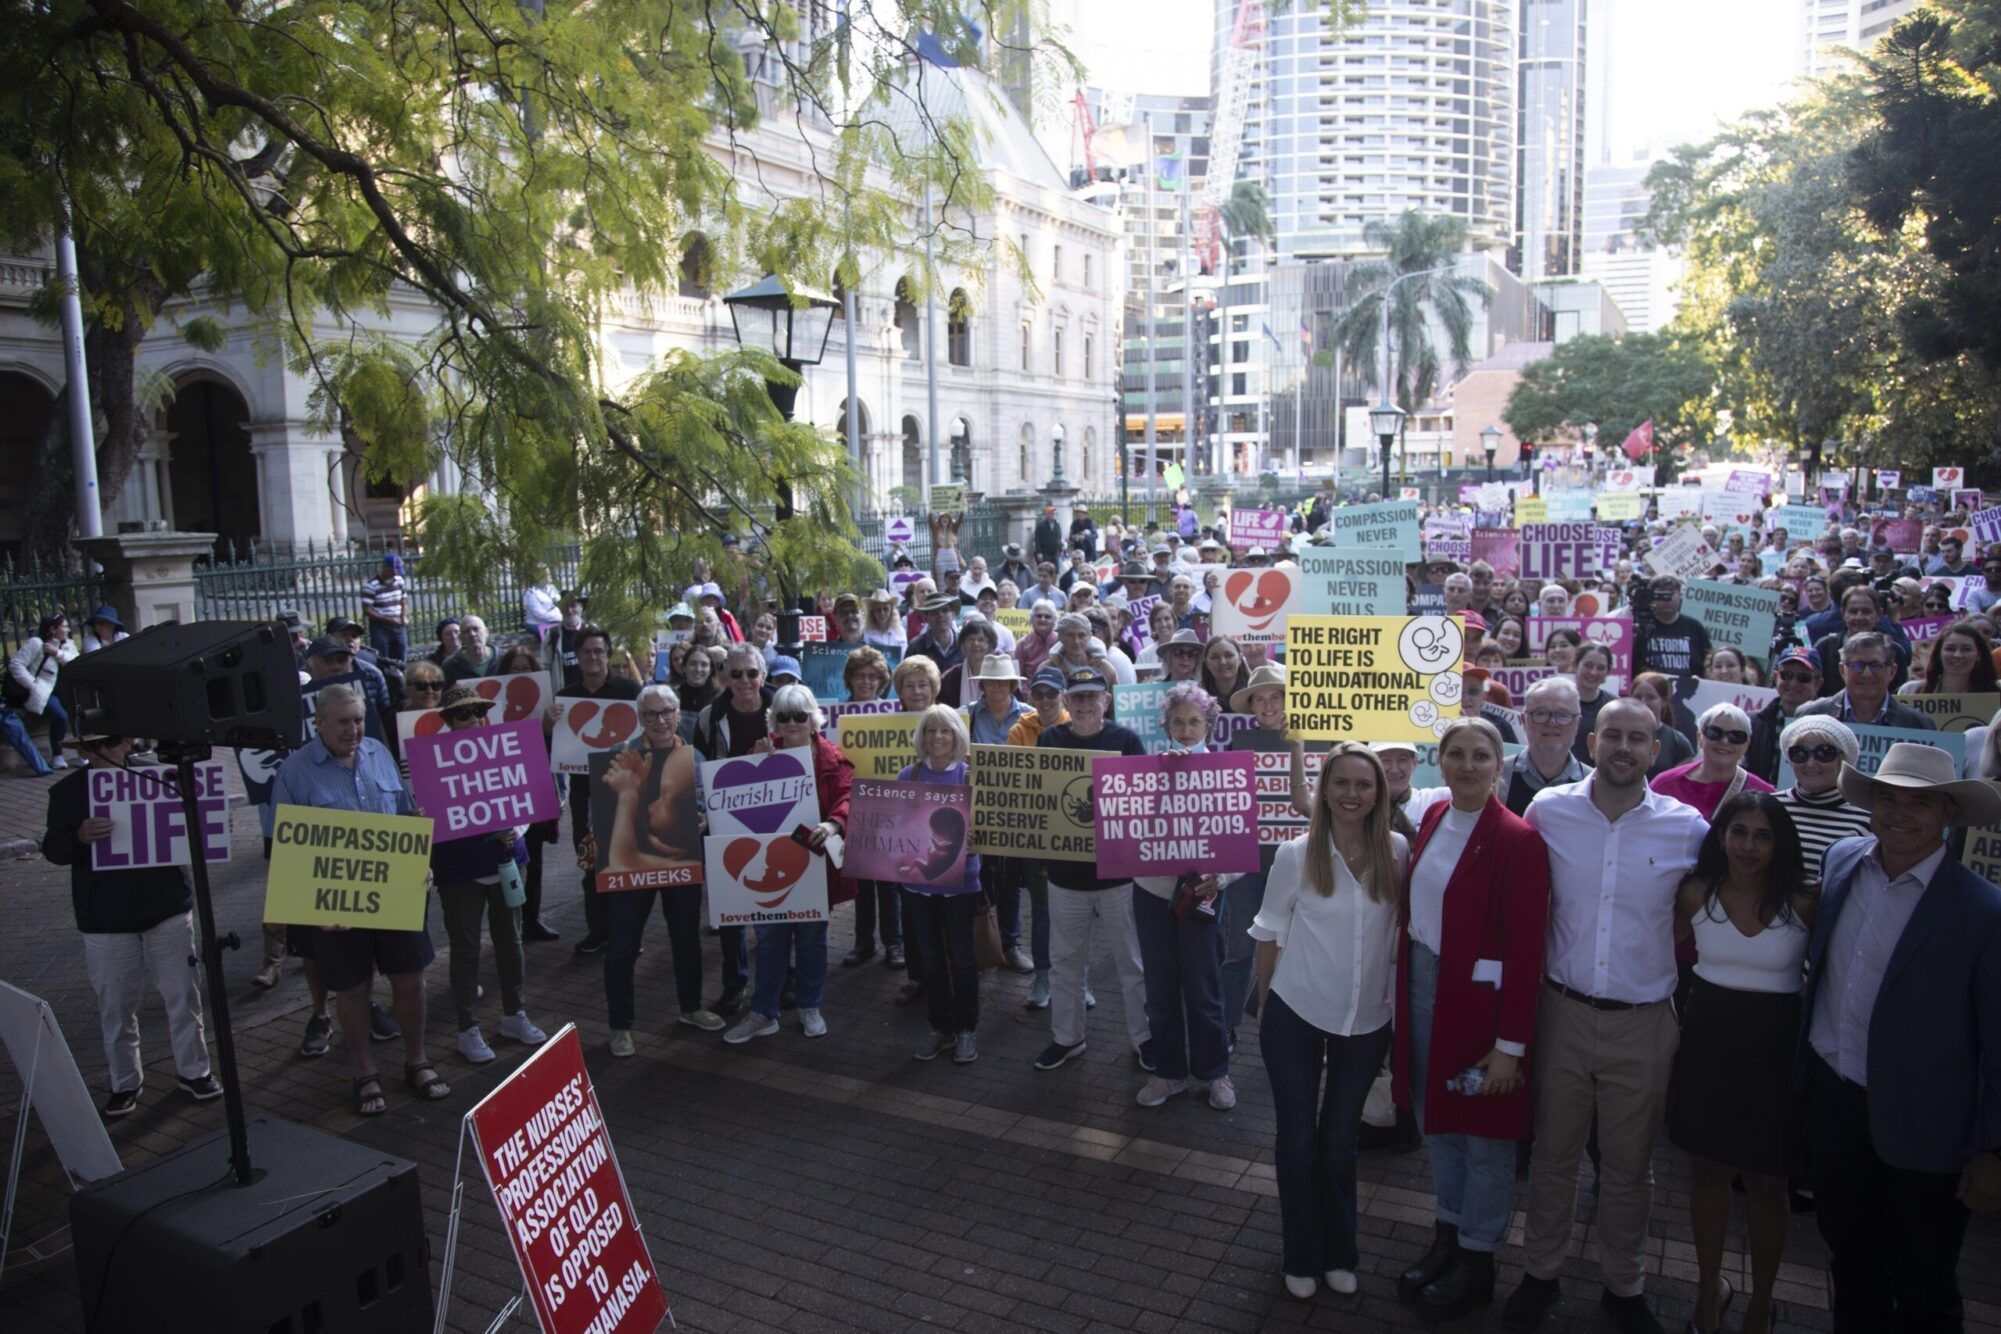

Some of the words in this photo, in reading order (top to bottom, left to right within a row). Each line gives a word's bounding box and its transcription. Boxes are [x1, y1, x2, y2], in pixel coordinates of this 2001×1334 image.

[1234, 511, 1260, 528] LIFE
[1336, 508, 1417, 529] COMPASSION
[1779, 508, 1826, 520] COMPASSION
[1789, 519, 1812, 527] NEVER
[1357, 527, 1397, 543] NEVER
[1475, 530, 1508, 538] Science
[1522, 523, 1595, 542] CHOOSE
[1789, 528, 1808, 536] KILLS
[1428, 541, 1471, 553] CHOOSE
[1302, 558, 1403, 577] COMPASSION
[1522, 543, 1594, 578] LIFE
[1327, 581, 1378, 598] NEVER
[1685, 586, 1777, 614] COMPASSION
[996, 615, 1032, 627] COMPA
[1704, 608, 1750, 627] NEVER
[1290, 626, 1325, 645] THE
[1328, 627, 1382, 646] RIGHT
[1289, 649, 1314, 667] TO
[1317, 649, 1354, 667] LIFE
[1357, 650, 1375, 667] IS
[1290, 670, 1425, 690] FOUNDATIONAL
[1117, 690, 1165, 712] SPEA
[1289, 692, 1314, 709] TO
[1315, 693, 1349, 710] ALL
[1351, 693, 1409, 711] OTHER
[1117, 714, 1157, 736] THE
[1290, 714, 1354, 731] RIGHTS
[842, 730, 914, 749] COMPA
[433, 731, 522, 769] LOVE
[976, 750, 1036, 770] BABIES
[1039, 753, 1085, 772] BORN
[440, 763, 528, 799] THEM
[975, 770, 1022, 789] ALIVE
[1025, 773, 1042, 790] IN
[1101, 772, 1170, 796] 26,583
[1175, 768, 1248, 791] BABIES
[707, 783, 774, 811] Cherish
[780, 775, 814, 803] Life
[859, 784, 916, 800] Science
[924, 791, 965, 804] says:
[975, 791, 1058, 811] ABORTION
[446, 792, 534, 831] BOTH
[1098, 796, 1156, 818] WERE
[1159, 791, 1252, 815] ABORTED
[852, 811, 895, 828] SHE'S
[975, 810, 1049, 830] DESERVE
[1102, 819, 1124, 840] IN
[1128, 818, 1168, 841] QLD
[1173, 817, 1194, 837] IN
[1199, 814, 1250, 836] 2019.
[93, 799, 228, 867] LIFE
[277, 820, 429, 856] COMPASSION
[975, 830, 1047, 850] MEDICAL
[850, 835, 921, 854] HUMAN
[1139, 838, 1216, 862] SHAME.
[313, 856, 389, 883] NEVER
[608, 876, 624, 889] 21
[629, 868, 692, 887] WEEKS
[315, 888, 380, 914] KILLS
[720, 909, 821, 923] lovethemboth
[493, 1128, 529, 1180] THE
[525, 1072, 582, 1150] NURSES'
[500, 1103, 602, 1221] PROFESSIONAL
[514, 1133, 608, 1251] ASSOCIATION
[549, 1217, 570, 1258] OF
[569, 1186, 599, 1235] QLD
[543, 1274, 566, 1312] IS
[561, 1201, 623, 1290] OPPOSED
[585, 1265, 610, 1305] TO
